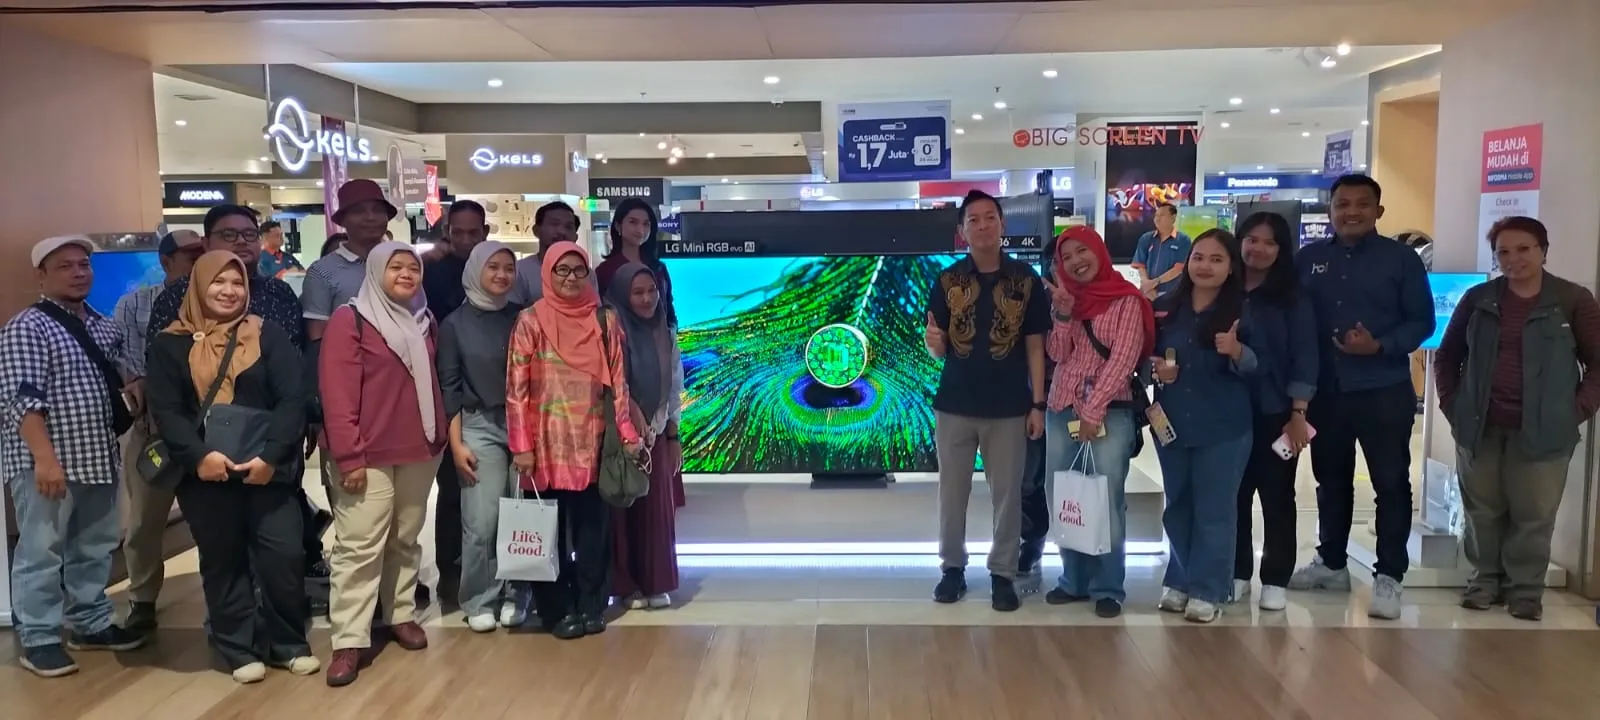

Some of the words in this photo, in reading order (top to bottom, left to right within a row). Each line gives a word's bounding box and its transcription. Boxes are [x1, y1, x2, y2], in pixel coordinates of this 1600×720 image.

[852, 134, 896, 143] CASHBACK
[1032, 127, 1068, 146] BIG
[1079, 126, 1167, 146] SCREEN
[1175, 125, 1206, 145] TV
[1488, 136, 1528, 153] BELANJA
[857, 142, 887, 171] 1,7
[1486, 154, 1519, 168] MUDAH
[1520, 151, 1529, 165] di
[1051, 176, 1073, 190] LG
[1227, 177, 1279, 187] Panasonic
[180, 190, 225, 201] MODENA
[596, 186, 651, 197] SAMSUNG
[657, 221, 679, 229] SONY
[665, 243, 680, 253] LG
[683, 242, 705, 253] Mini
[706, 242, 729, 253] RGB
[744, 241, 755, 253] AI
[1021, 237, 1035, 247] 4K
[1062, 500, 1082, 514] Life's
[1059, 511, 1086, 528] Good.
[512, 530, 543, 544] Life's
[507, 543, 546, 557] Good.
